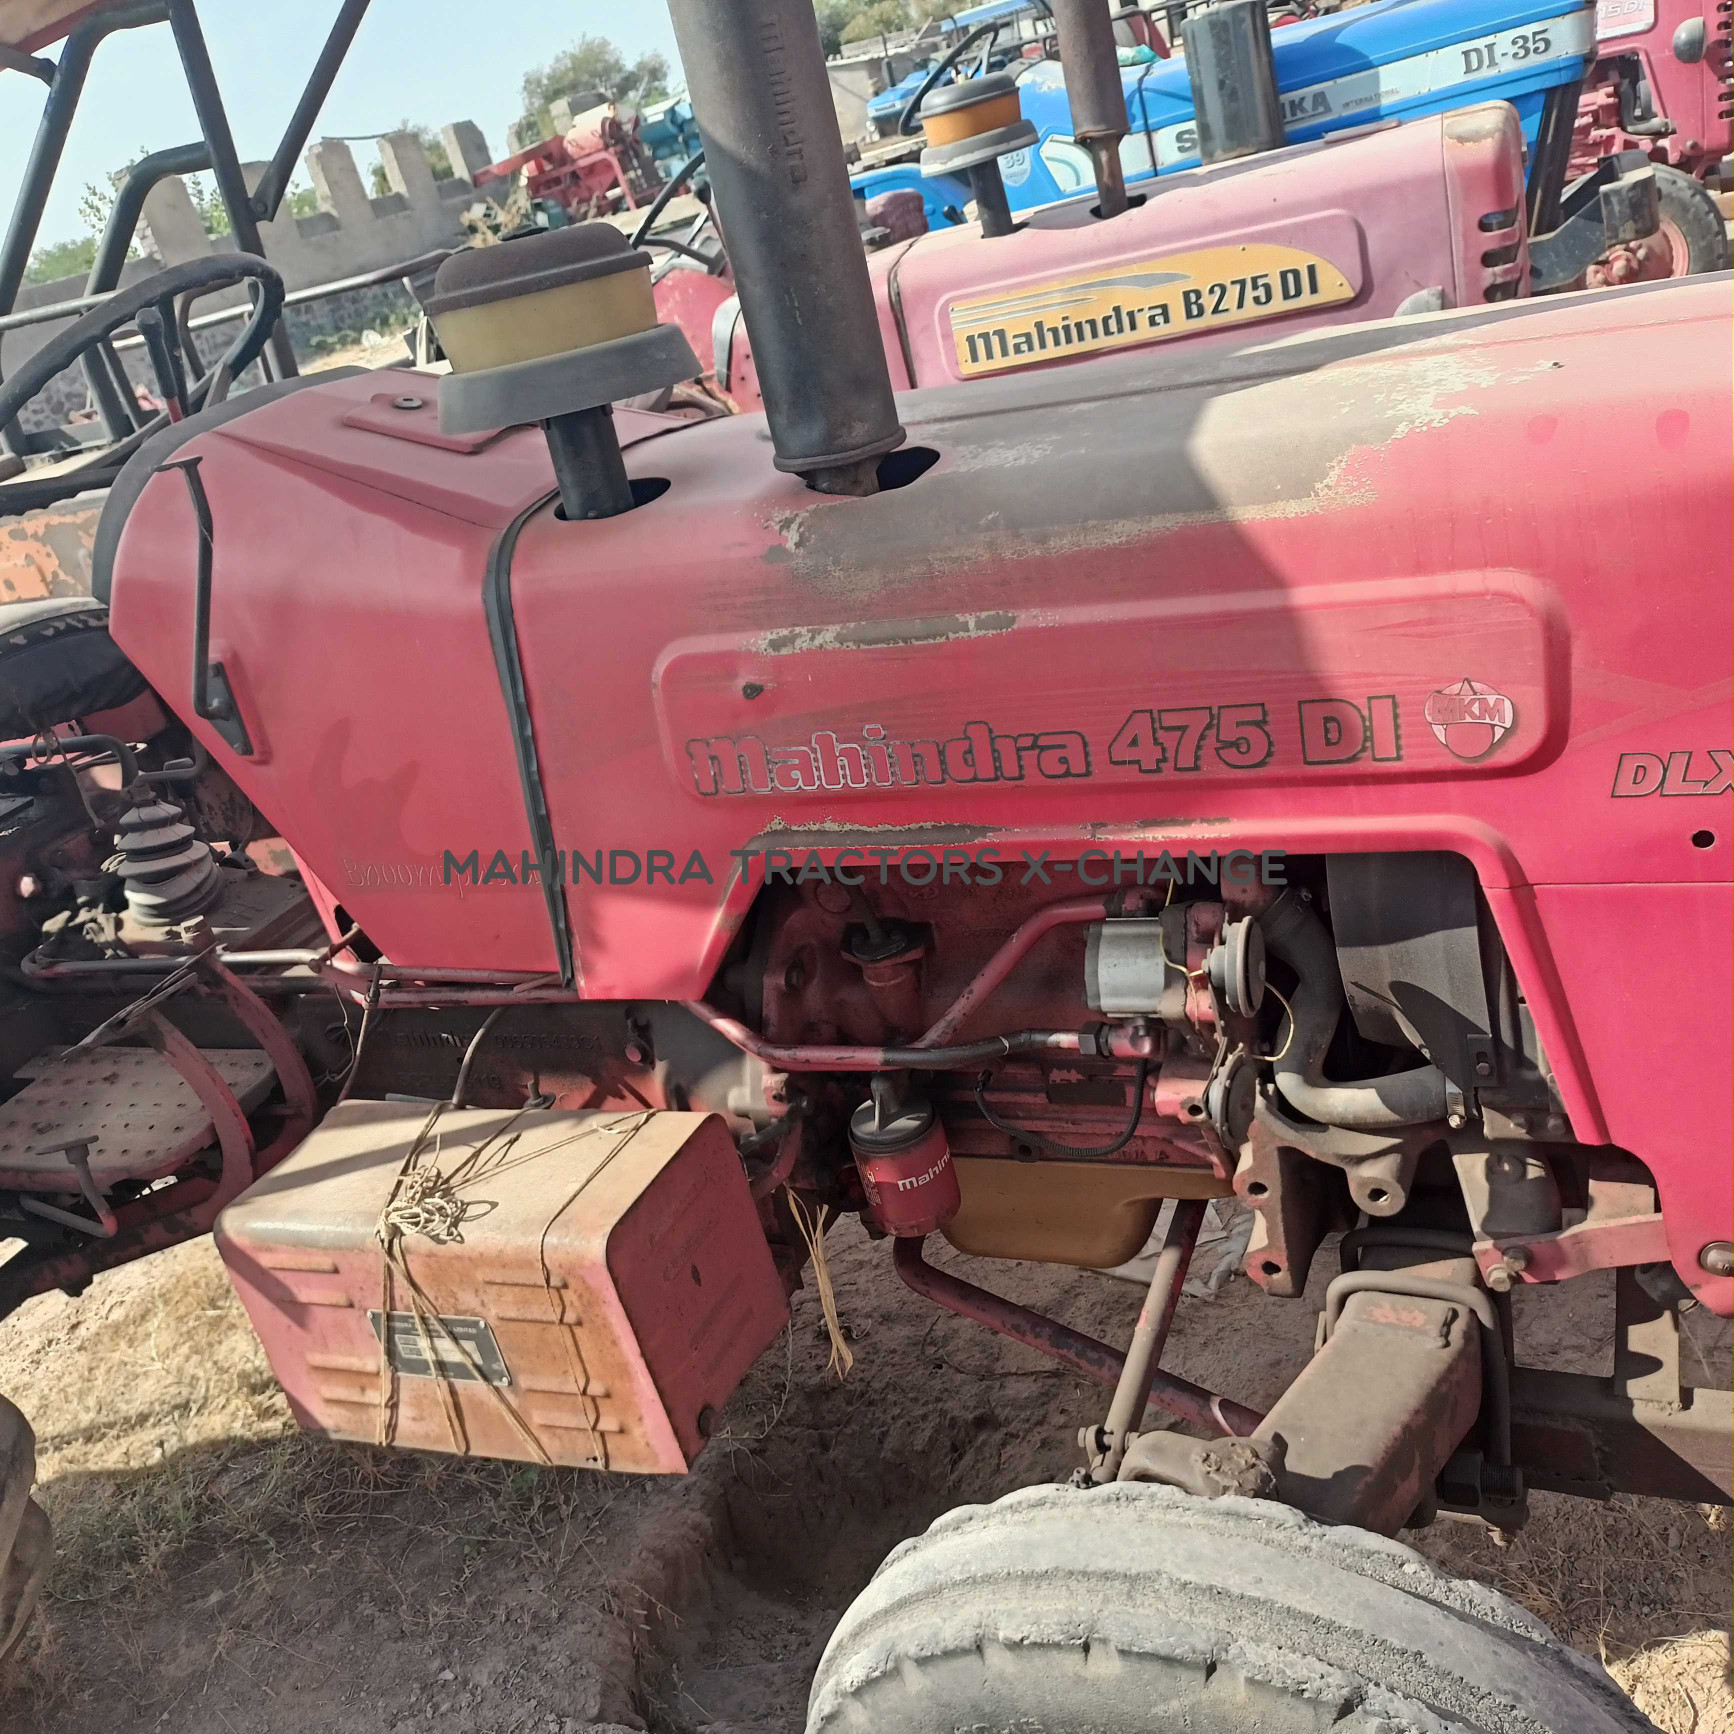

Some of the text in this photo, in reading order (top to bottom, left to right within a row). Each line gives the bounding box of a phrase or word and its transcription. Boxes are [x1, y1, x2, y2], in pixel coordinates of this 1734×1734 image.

[1461, 28, 1551, 75] DI-35
[965, 263, 1319, 364] Mahindra B275 DI
[685, 695, 1404, 796] Mahindra 475 DI
[1431, 695, 1506, 724] MKM
